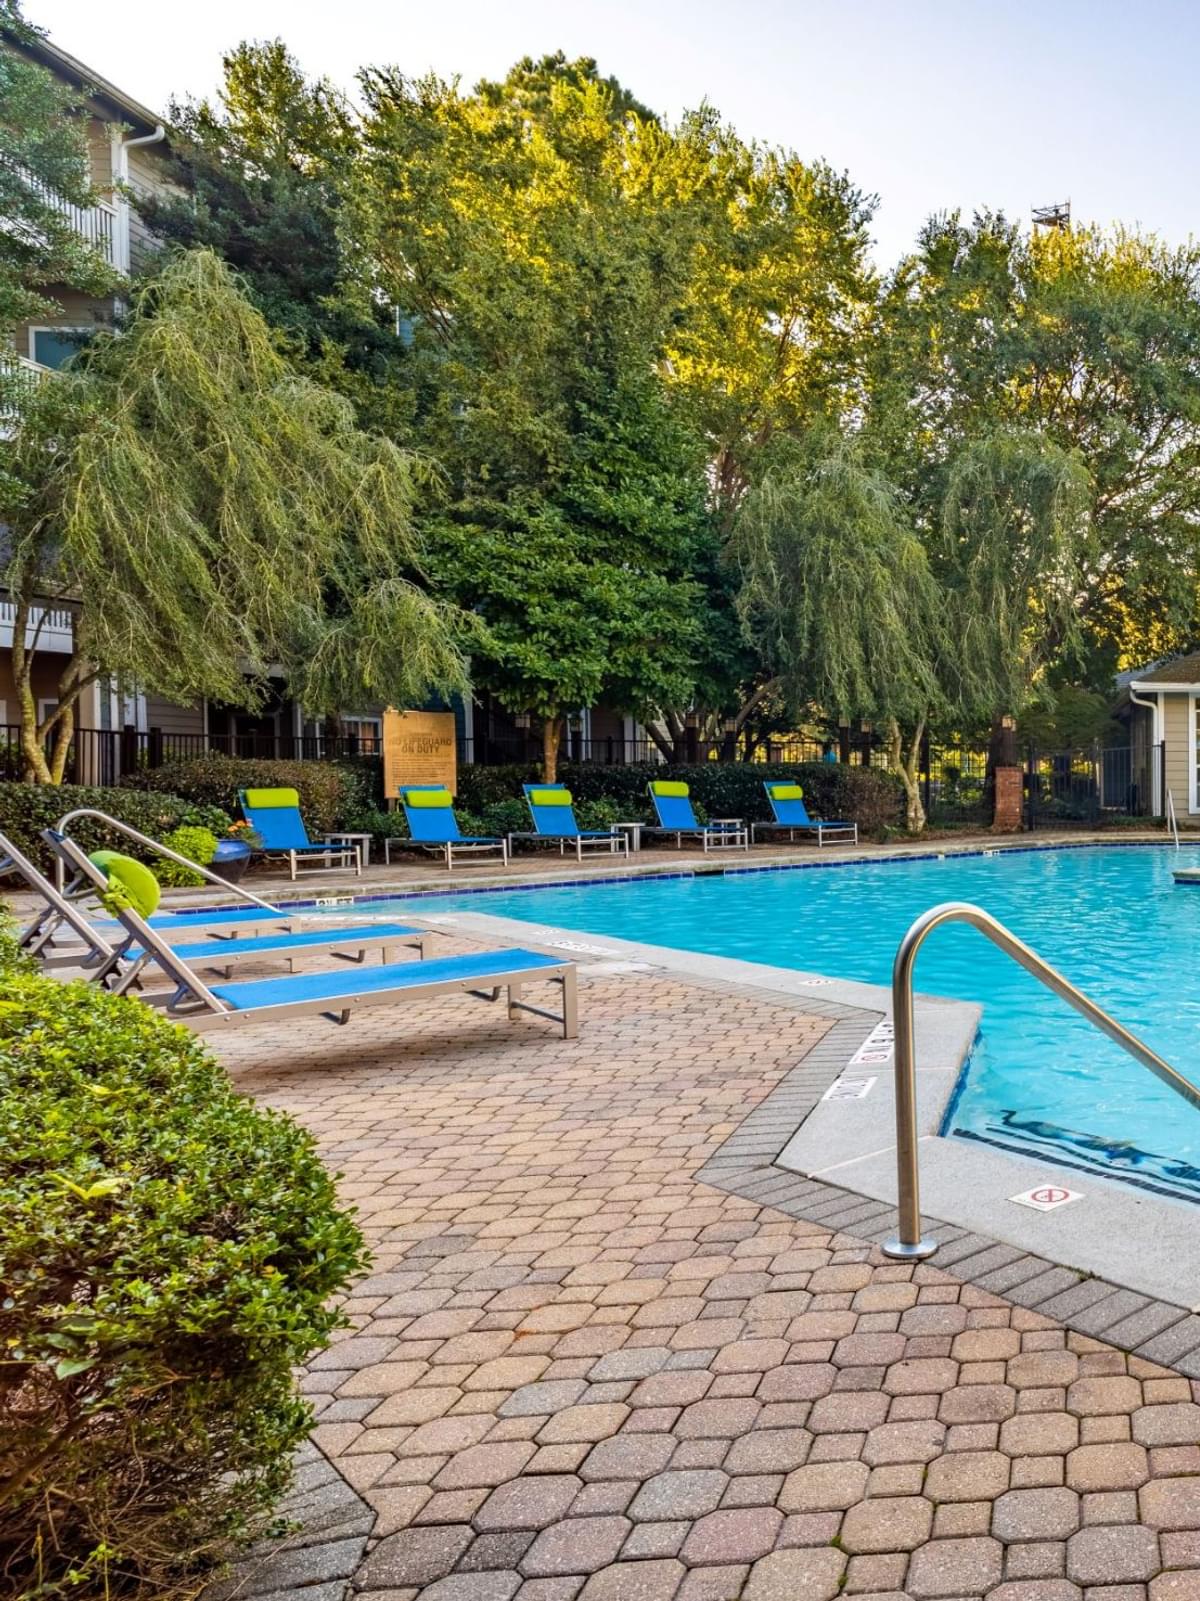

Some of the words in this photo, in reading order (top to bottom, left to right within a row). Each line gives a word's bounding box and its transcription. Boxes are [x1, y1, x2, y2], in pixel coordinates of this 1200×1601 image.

[403, 736, 452, 747] LIFEGUARD
[401, 744, 415, 754] ON
[417, 743, 440, 754] DUTY
